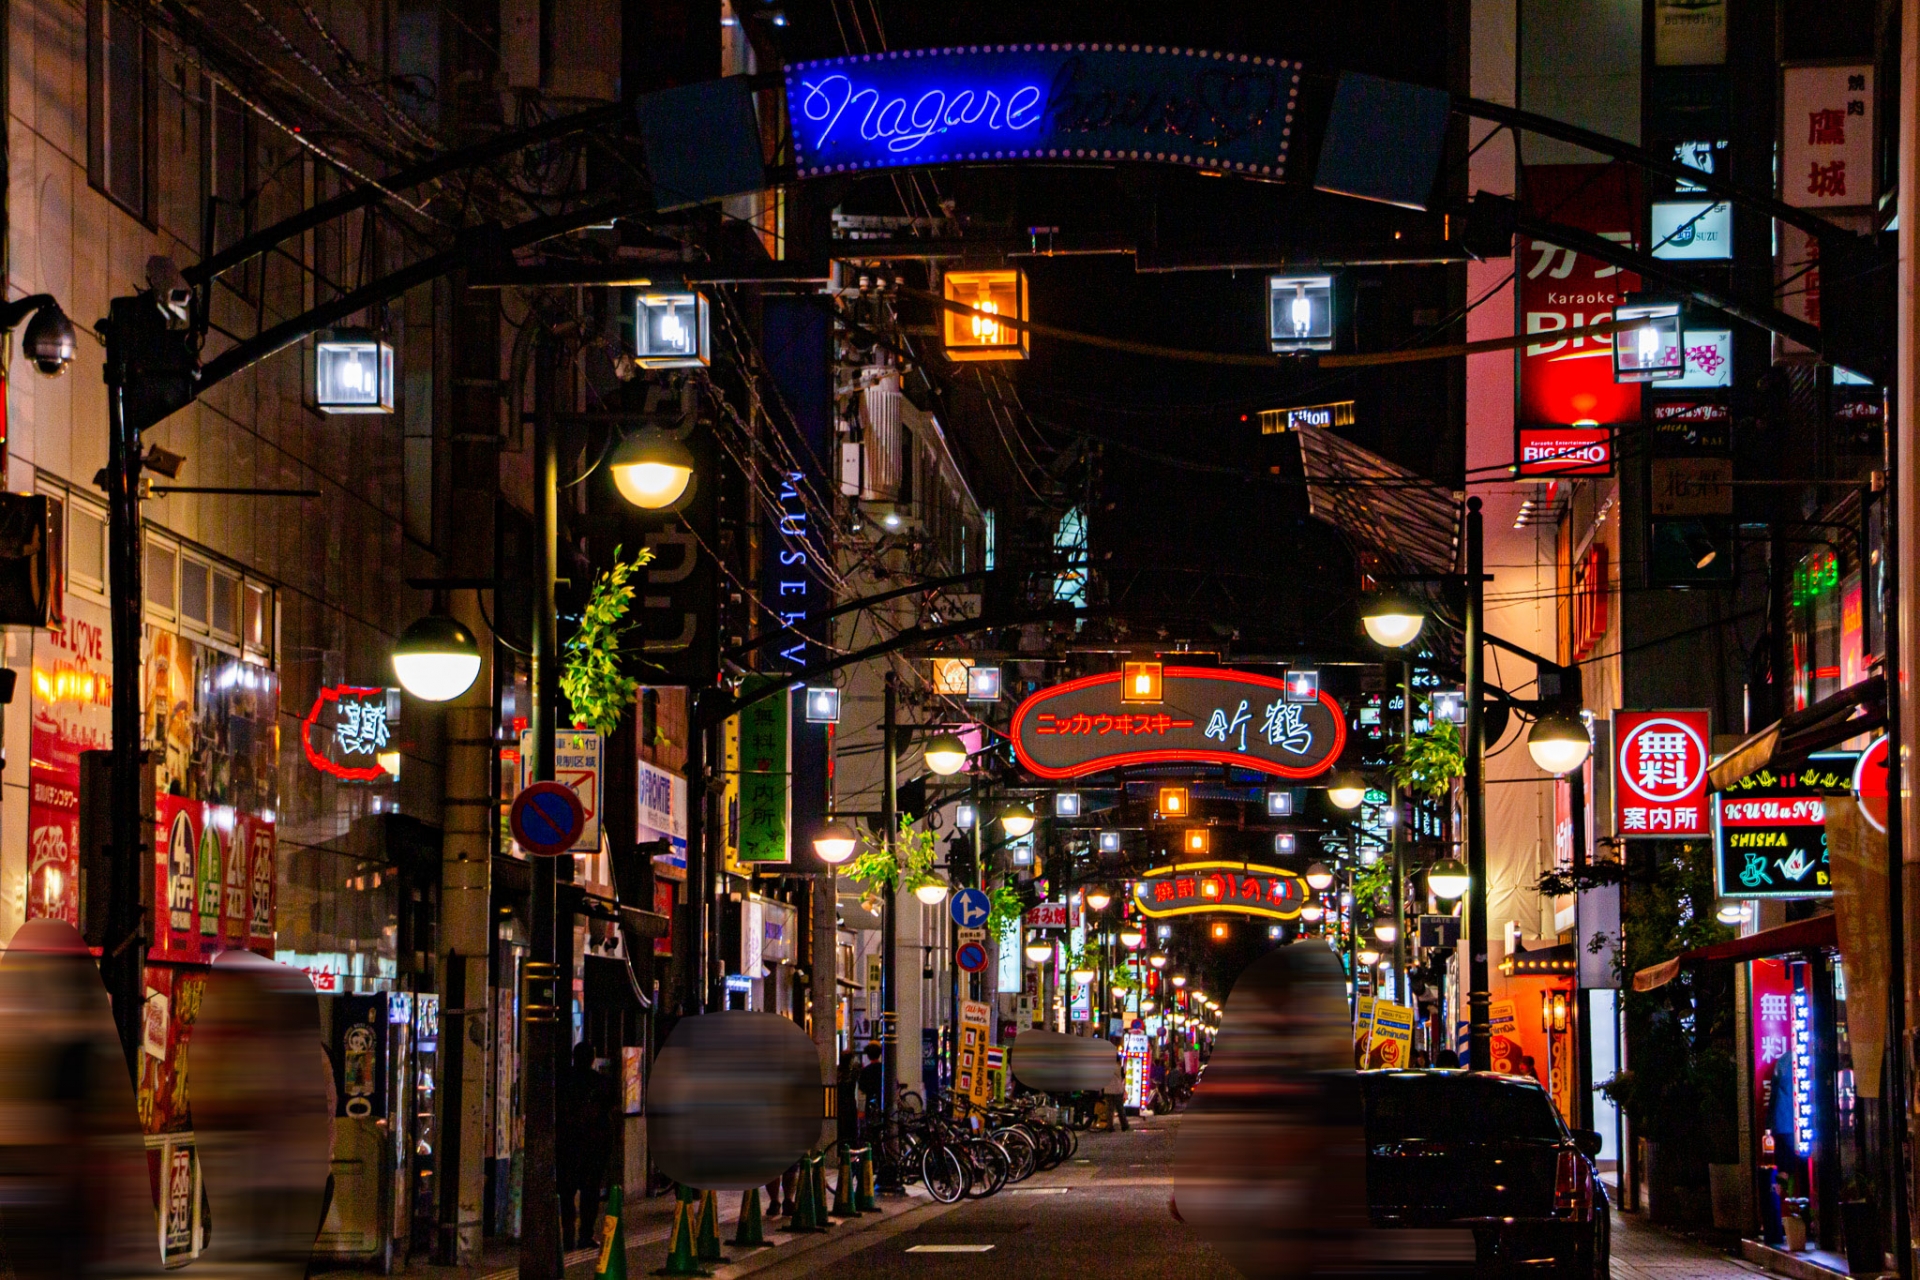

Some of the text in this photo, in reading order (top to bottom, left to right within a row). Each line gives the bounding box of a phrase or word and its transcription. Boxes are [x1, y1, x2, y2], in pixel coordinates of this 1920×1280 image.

[1716, 140, 1729, 150] 6F
[1807, 109, 1847, 197] 鷹城
[1714, 206, 1727, 214] 5F
[1695, 231, 1718, 242] SUZU
[1548, 291, 1615, 305] Karaoke
[1287, 408, 1331, 428] Hilton
[1523, 446, 1606, 463] BIG ECHO
[1036, 713, 1194, 736] ニッカウヰスキー
[1637, 730, 1689, 790] 無料
[1623, 807, 1699, 830] 案内所
[1730, 832, 1789, 848] SHISHA
[1434, 924, 1445, 946] 1
